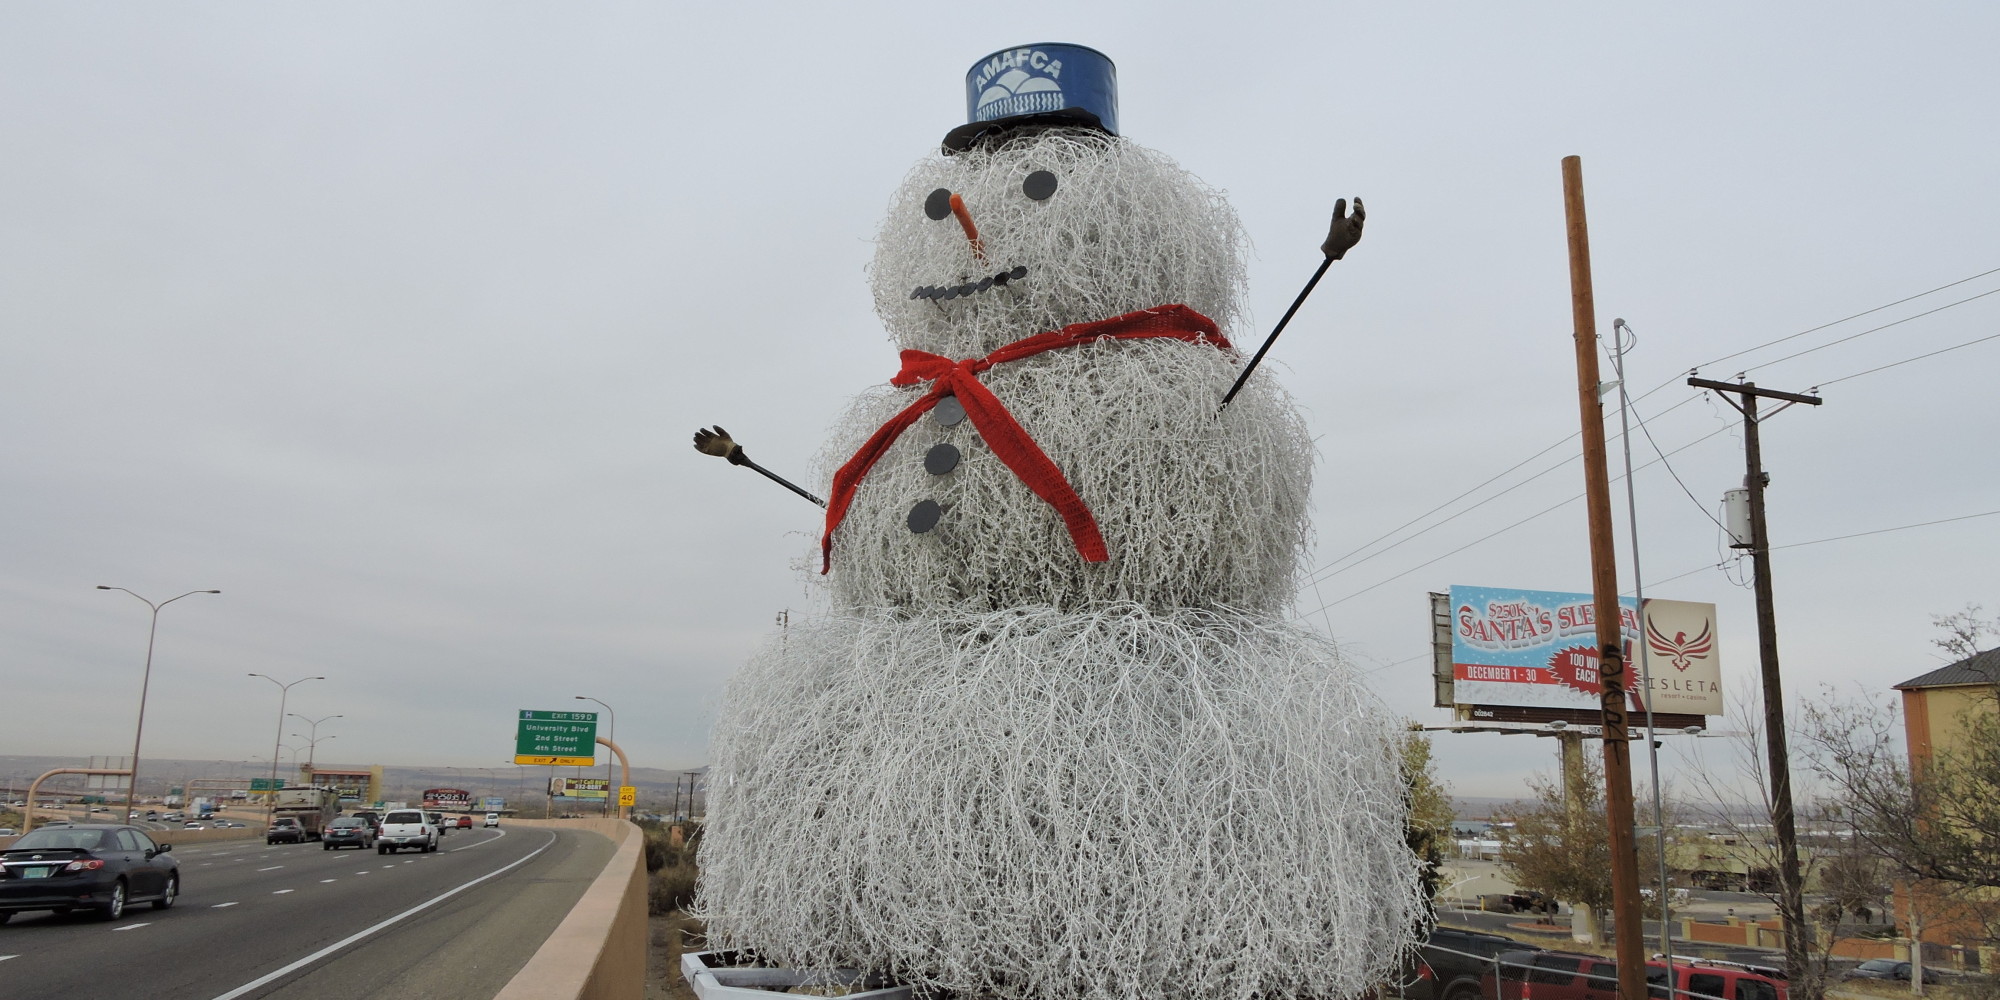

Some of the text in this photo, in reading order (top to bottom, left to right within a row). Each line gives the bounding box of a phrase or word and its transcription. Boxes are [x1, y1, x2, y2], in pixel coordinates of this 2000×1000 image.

[975, 48, 1063, 93] AMAFCA
[1488, 602, 1527, 619] $250K
[1459, 603, 1639, 643] SANTA'S SLEH
[1569, 653, 1585, 667] 100
[1467, 666, 1511, 681] DECEMBER
[1513, 668, 1517, 681] 1
[1525, 668, 1537, 682] 30
[1575, 667, 1596, 684] EACH
[1647, 677, 1719, 693] ISLETA
[526, 724, 589, 733] University Blvd
